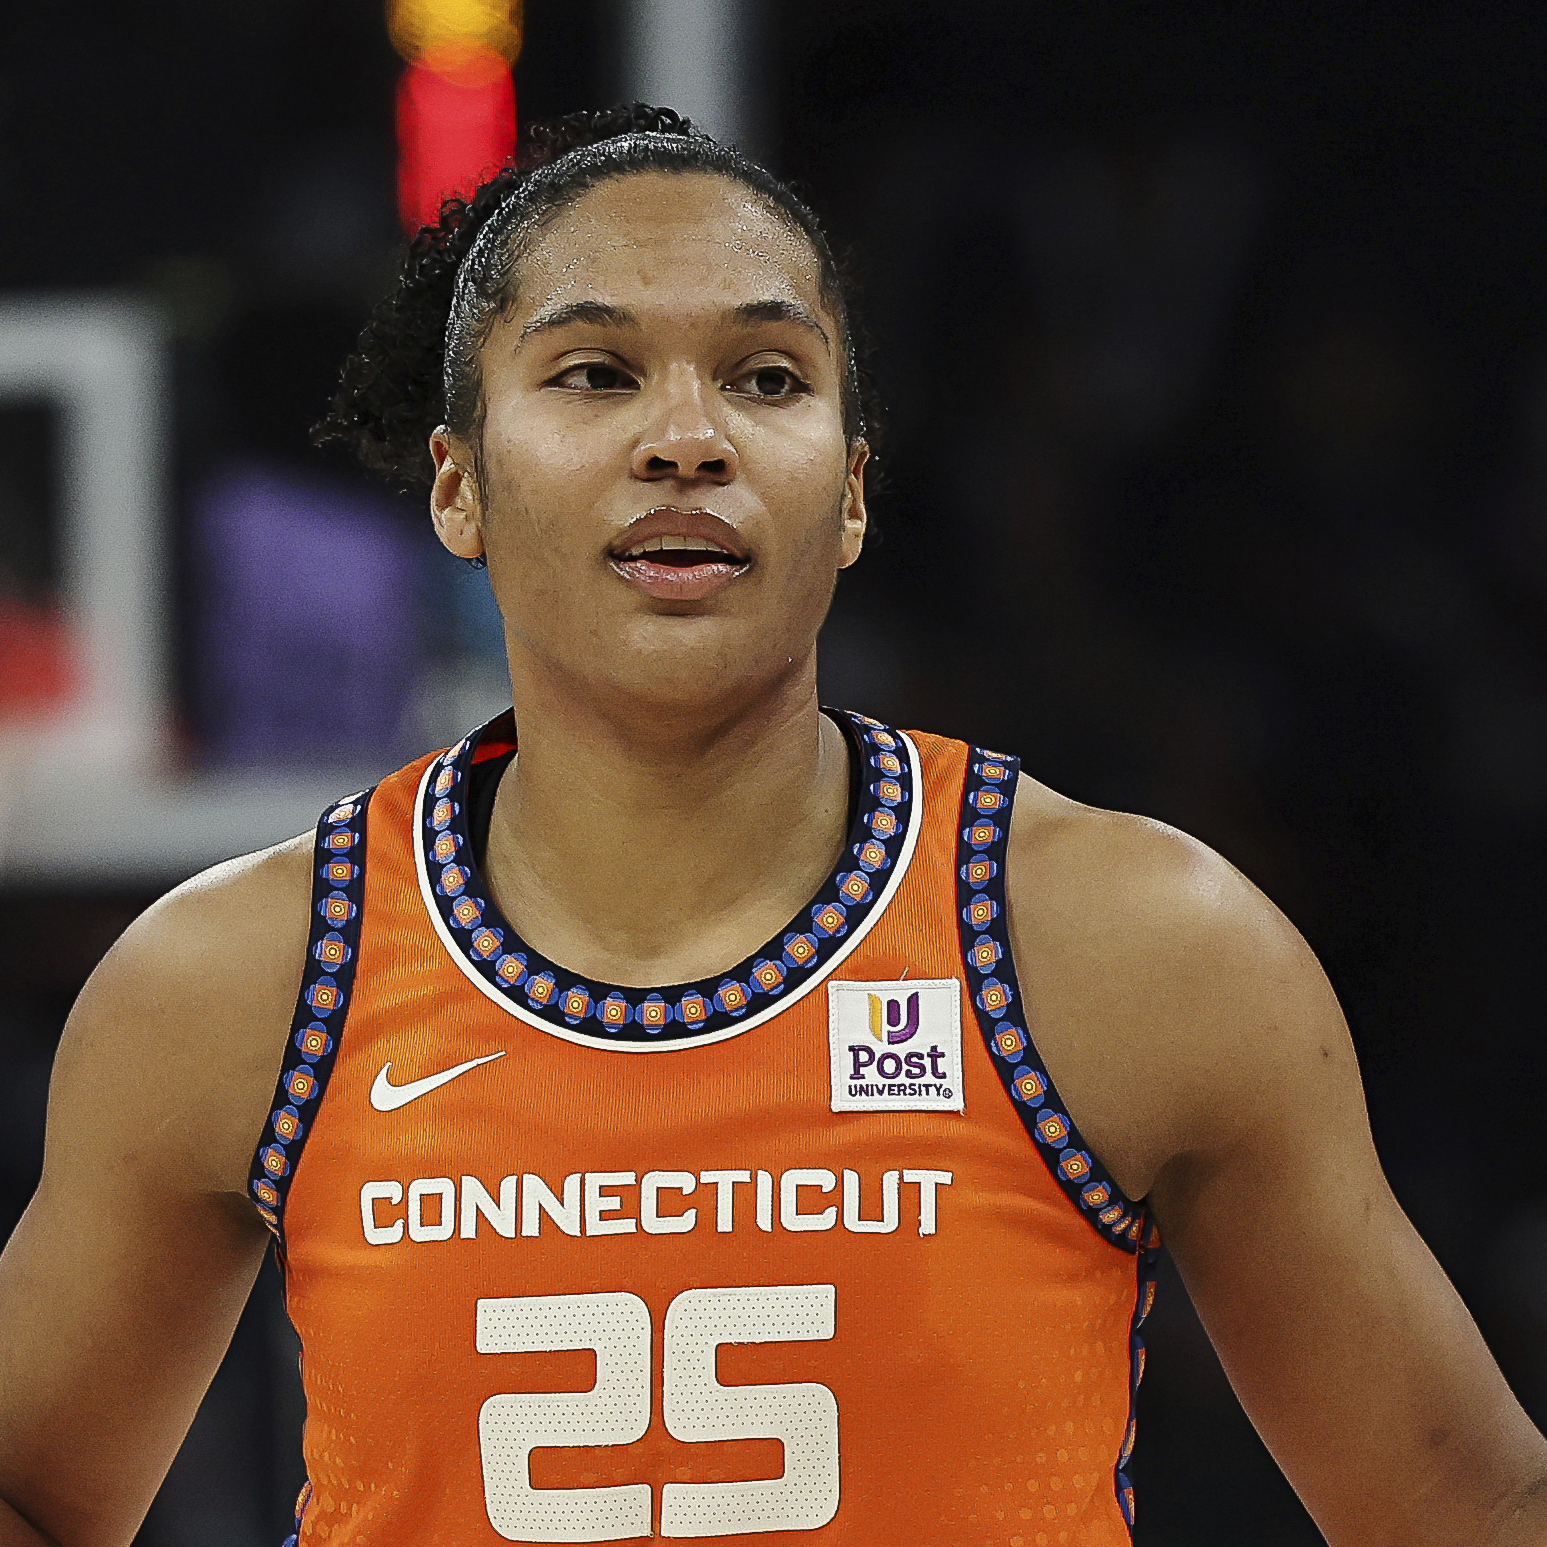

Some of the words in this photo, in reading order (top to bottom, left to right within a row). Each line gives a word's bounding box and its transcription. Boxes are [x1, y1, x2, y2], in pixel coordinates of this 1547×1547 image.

[847, 1045, 947, 1080] Post
[360, 1168, 953, 1245] CONNECTICUT
[476, 1284, 841, 1543] 25
